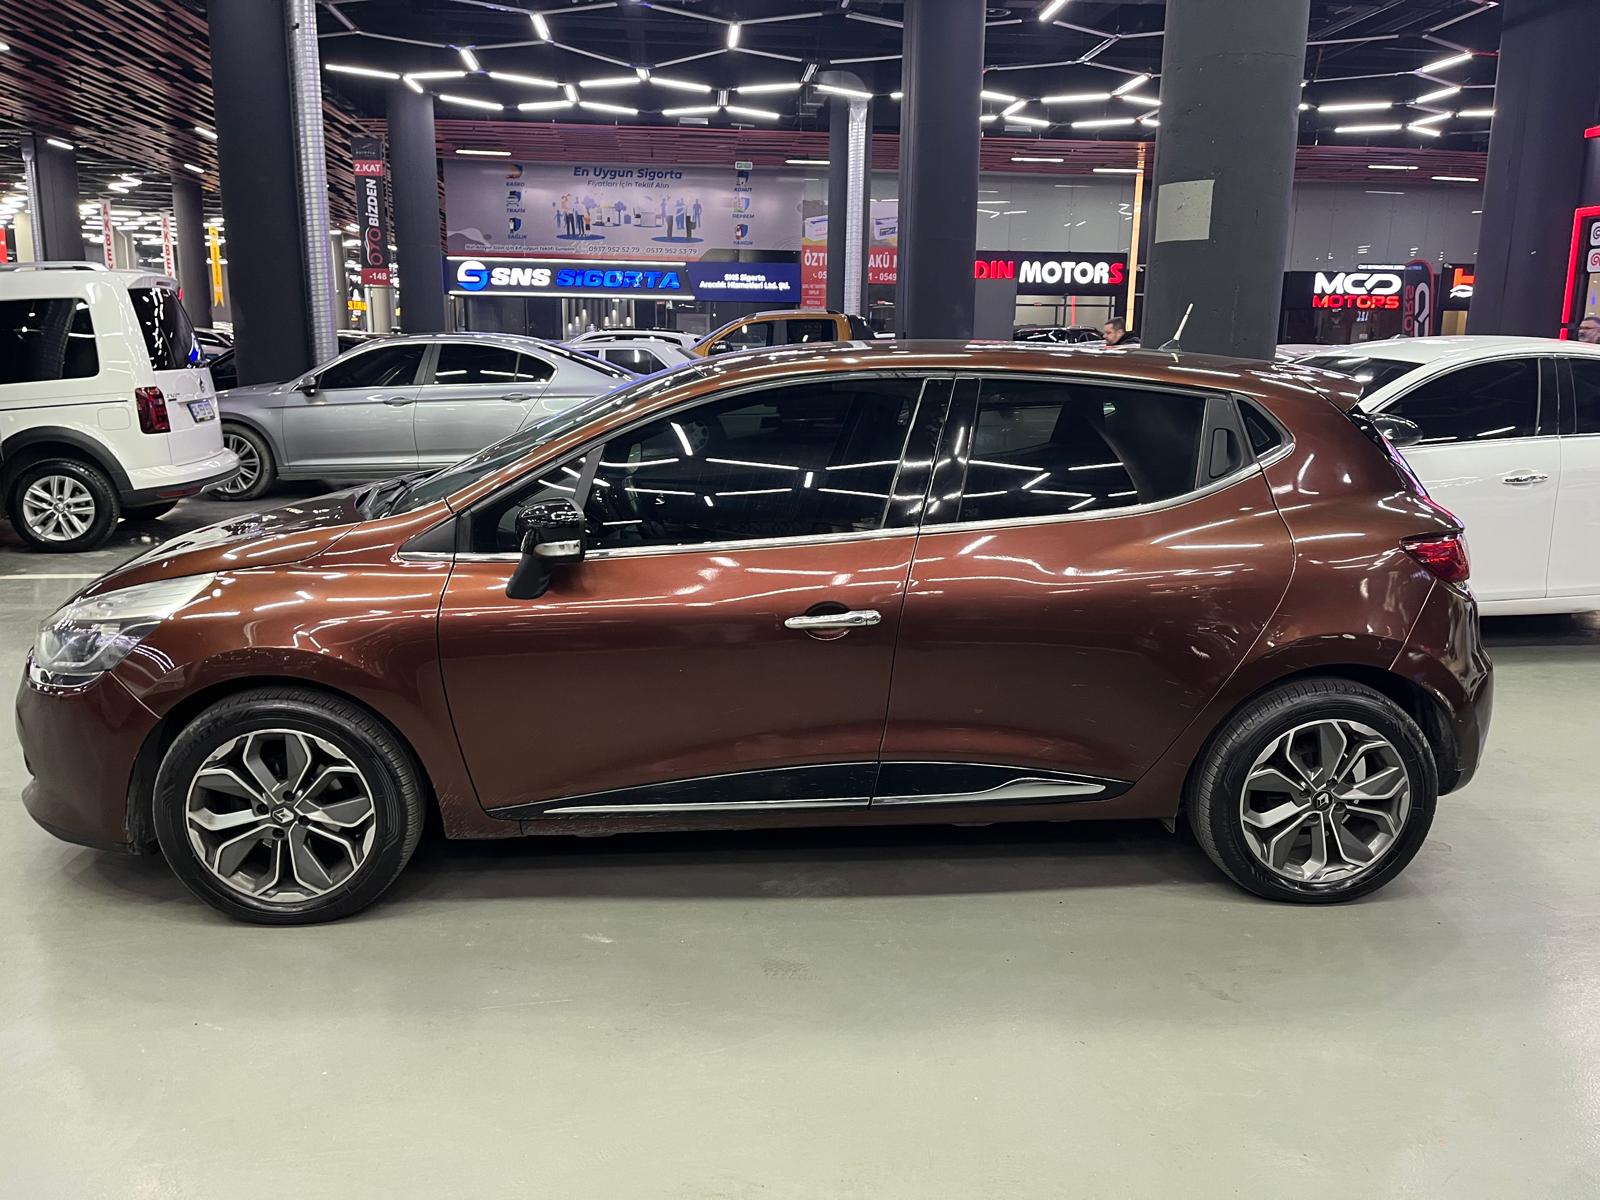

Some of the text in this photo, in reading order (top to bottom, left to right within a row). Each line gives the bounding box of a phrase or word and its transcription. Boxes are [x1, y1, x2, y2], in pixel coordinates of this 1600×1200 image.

[354, 163, 381, 172] 2.KAT
[573, 166, 683, 181] En Uygun Sigorta
[868, 251, 890, 268] AKÜ
[490, 267, 551, 287] SNS
[974, 260, 1124, 285] DIN MOTORS
[1313, 271, 1402, 295] MCD
[1312, 294, 1400, 309] MOTORS
